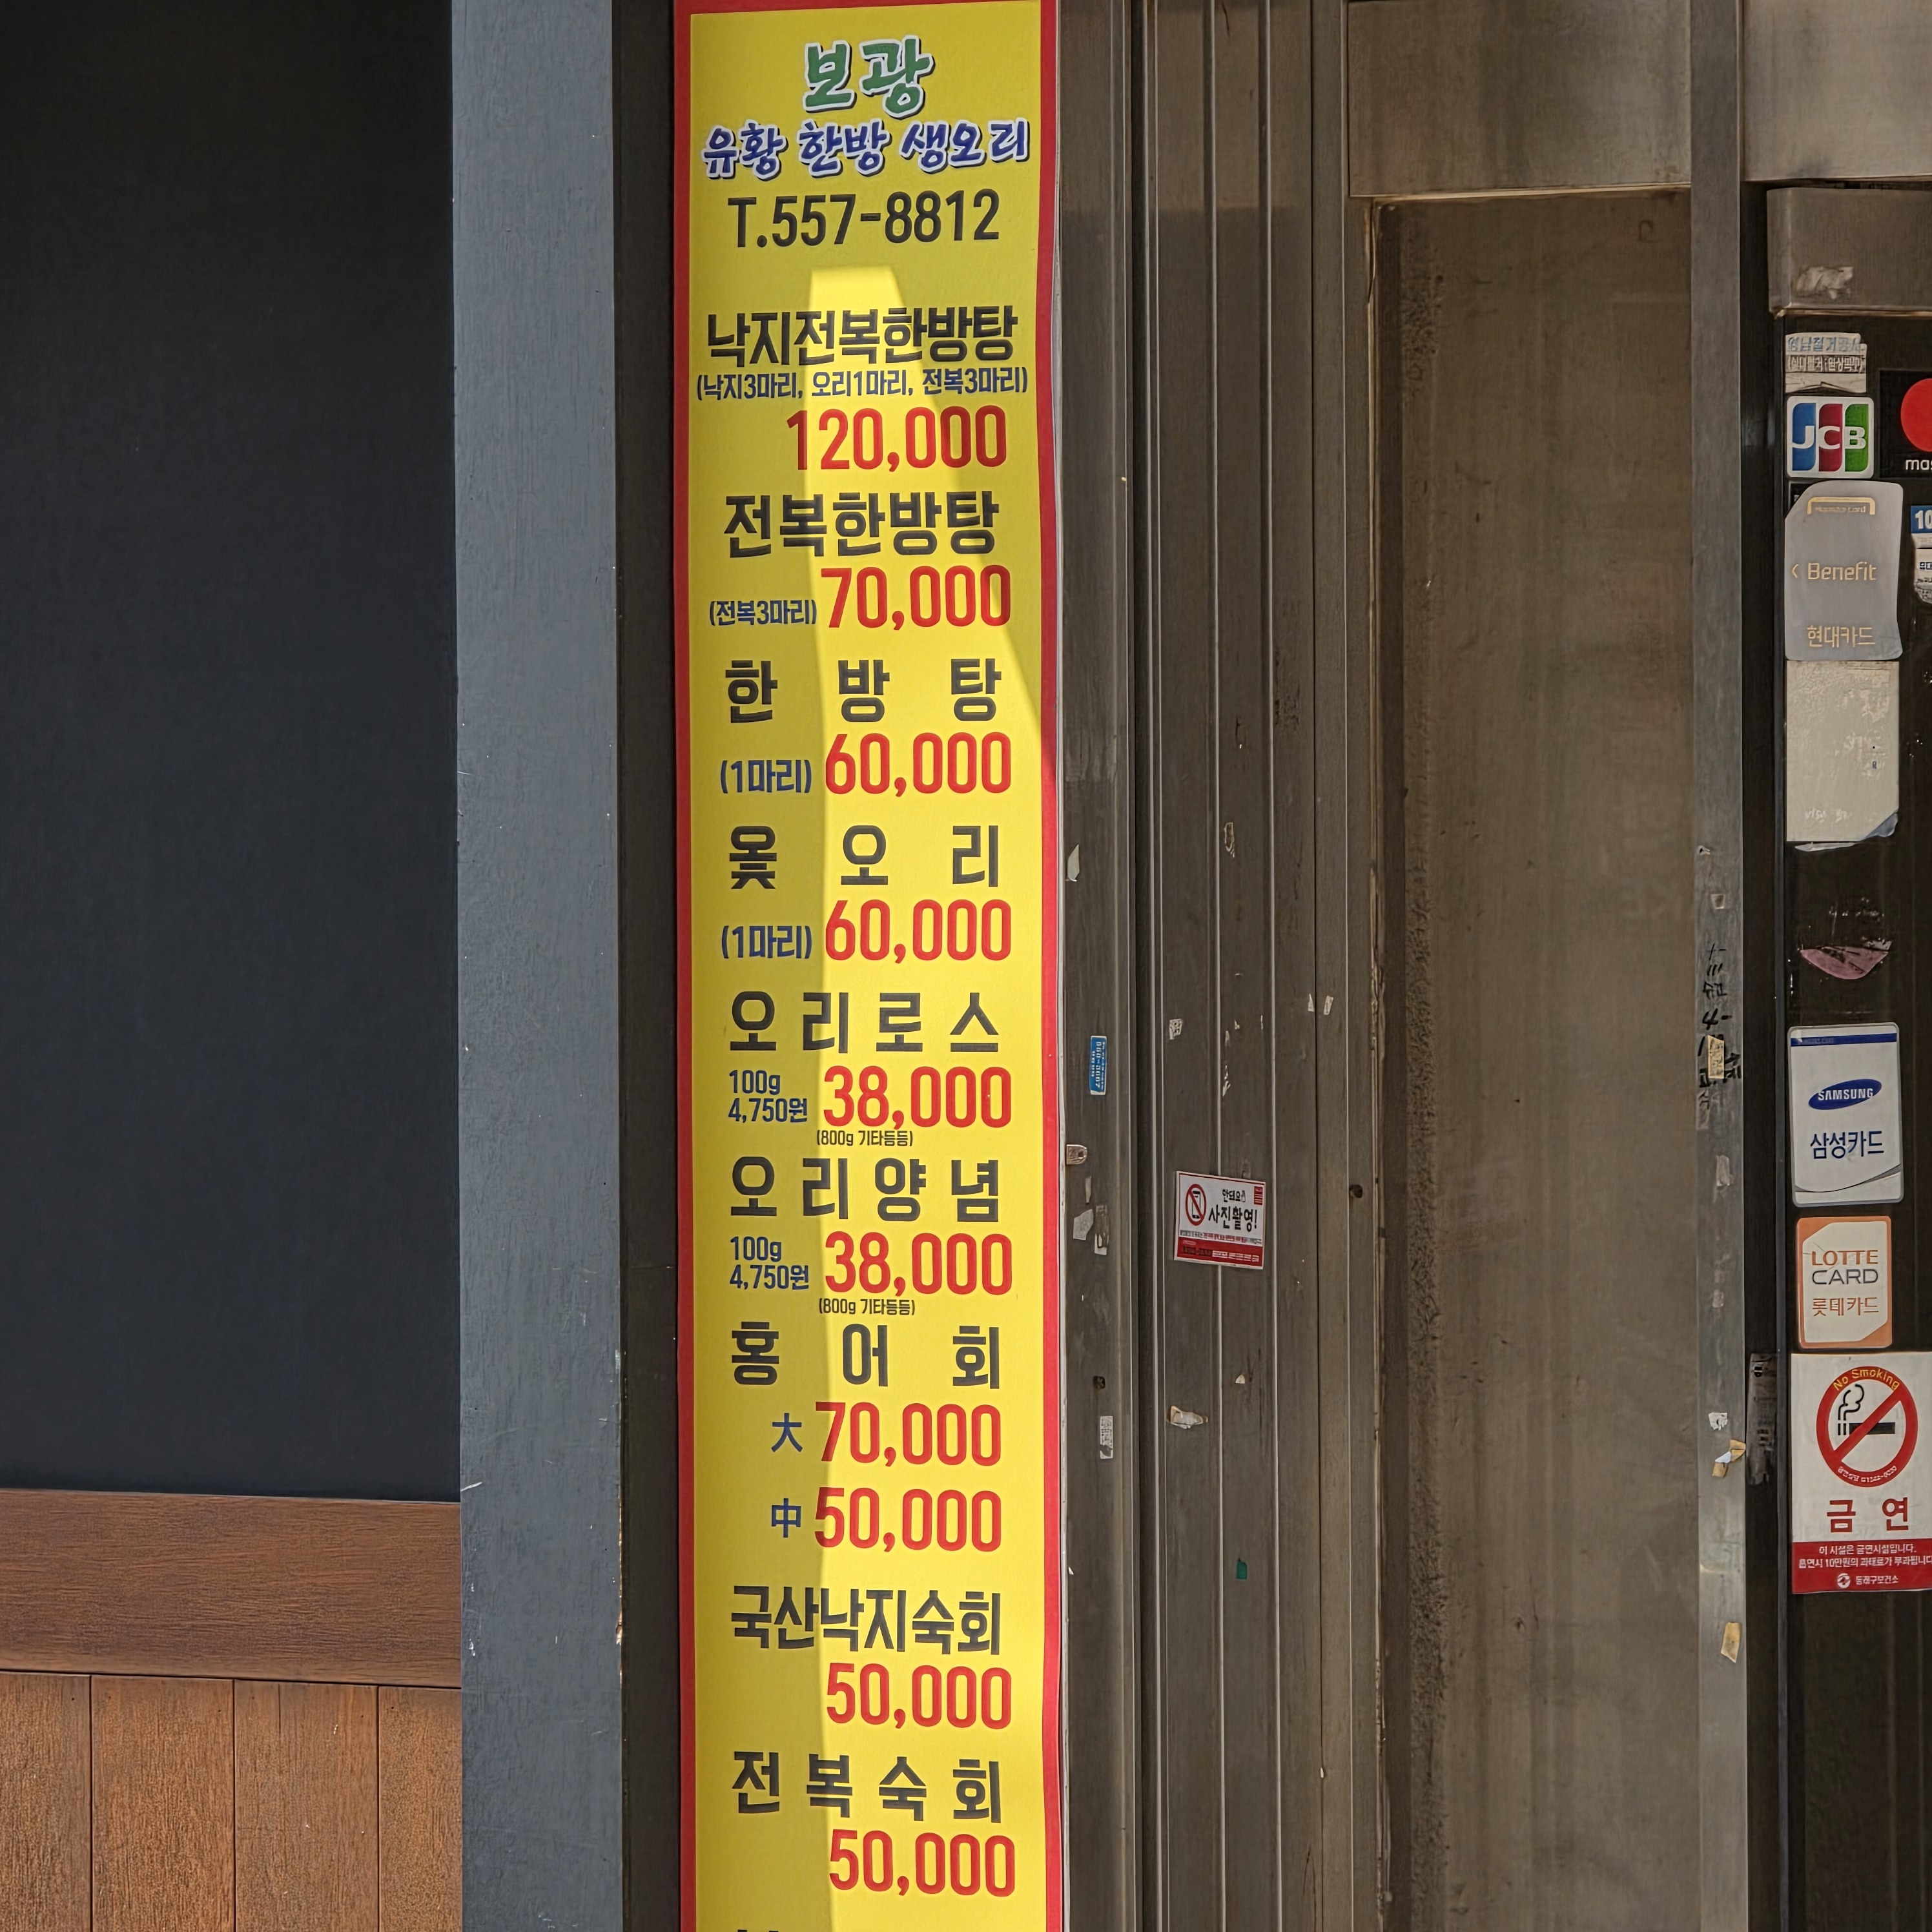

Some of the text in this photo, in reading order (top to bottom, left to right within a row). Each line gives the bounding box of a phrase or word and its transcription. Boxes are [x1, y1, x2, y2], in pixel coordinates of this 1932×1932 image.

[803, 35, 934, 119] 보광
[702, 118, 1031, 181] 유황 한방 생오리
[727, 189, 1000, 248] T.557-8812
[708, 305, 1018, 368] 낙지전복한방탕
[697, 366, 1028, 402] (낙지3마리, 오리1마리, 전복3마리)
[786, 405, 1007, 472] 120,000
[1792, 426, 1866, 449] JCB
[723, 490, 1000, 559] 전복한방탕
[1808, 562, 1876, 581] Benefit
[709, 564, 1011, 631] (전복3마리) 70,000
[1807, 625, 1876, 648] 현대카드
[720, 732, 1011, 797] (1마리) 60,000
[721, 899, 1011, 964] (1마리) 60,000
[729, 1069, 781, 1096] 100g
[823, 1065, 1011, 1130] 38,000
[1818, 1088, 1873, 1102] SAMSUNG
[728, 1097, 808, 1124] 4,750원
[816, 1129, 913, 1147] (800g 기타등등)
[1810, 1131, 1885, 1160] 삼성카드
[1208, 1204, 1258, 1232] 사진촬영!
[730, 1236, 782, 1262] 100g
[825, 1231, 1012, 1297] 38,000
[1811, 1249, 1879, 1266] LOTTE
[729, 1264, 809, 1290] 4,750원
[1812, 1268, 1879, 1285] CARD
[819, 1297, 915, 1315] (800g 기타등등)
[1812, 1297, 1880, 1317] 롯데카드
[1832, 1368, 1900, 1392] No Smoking
[771, 1401, 1001, 1467] 大 70,000
[771, 1486, 1002, 1552] 中 50,000
[1819, 1546, 1827, 1555] 이
[1830, 1545, 1855, 1555] 시설은
[731, 1585, 1001, 1655] 국산낙지숙회
[827, 1662, 1011, 1730] 50,000
[829, 1829, 1015, 1897] 50,000
